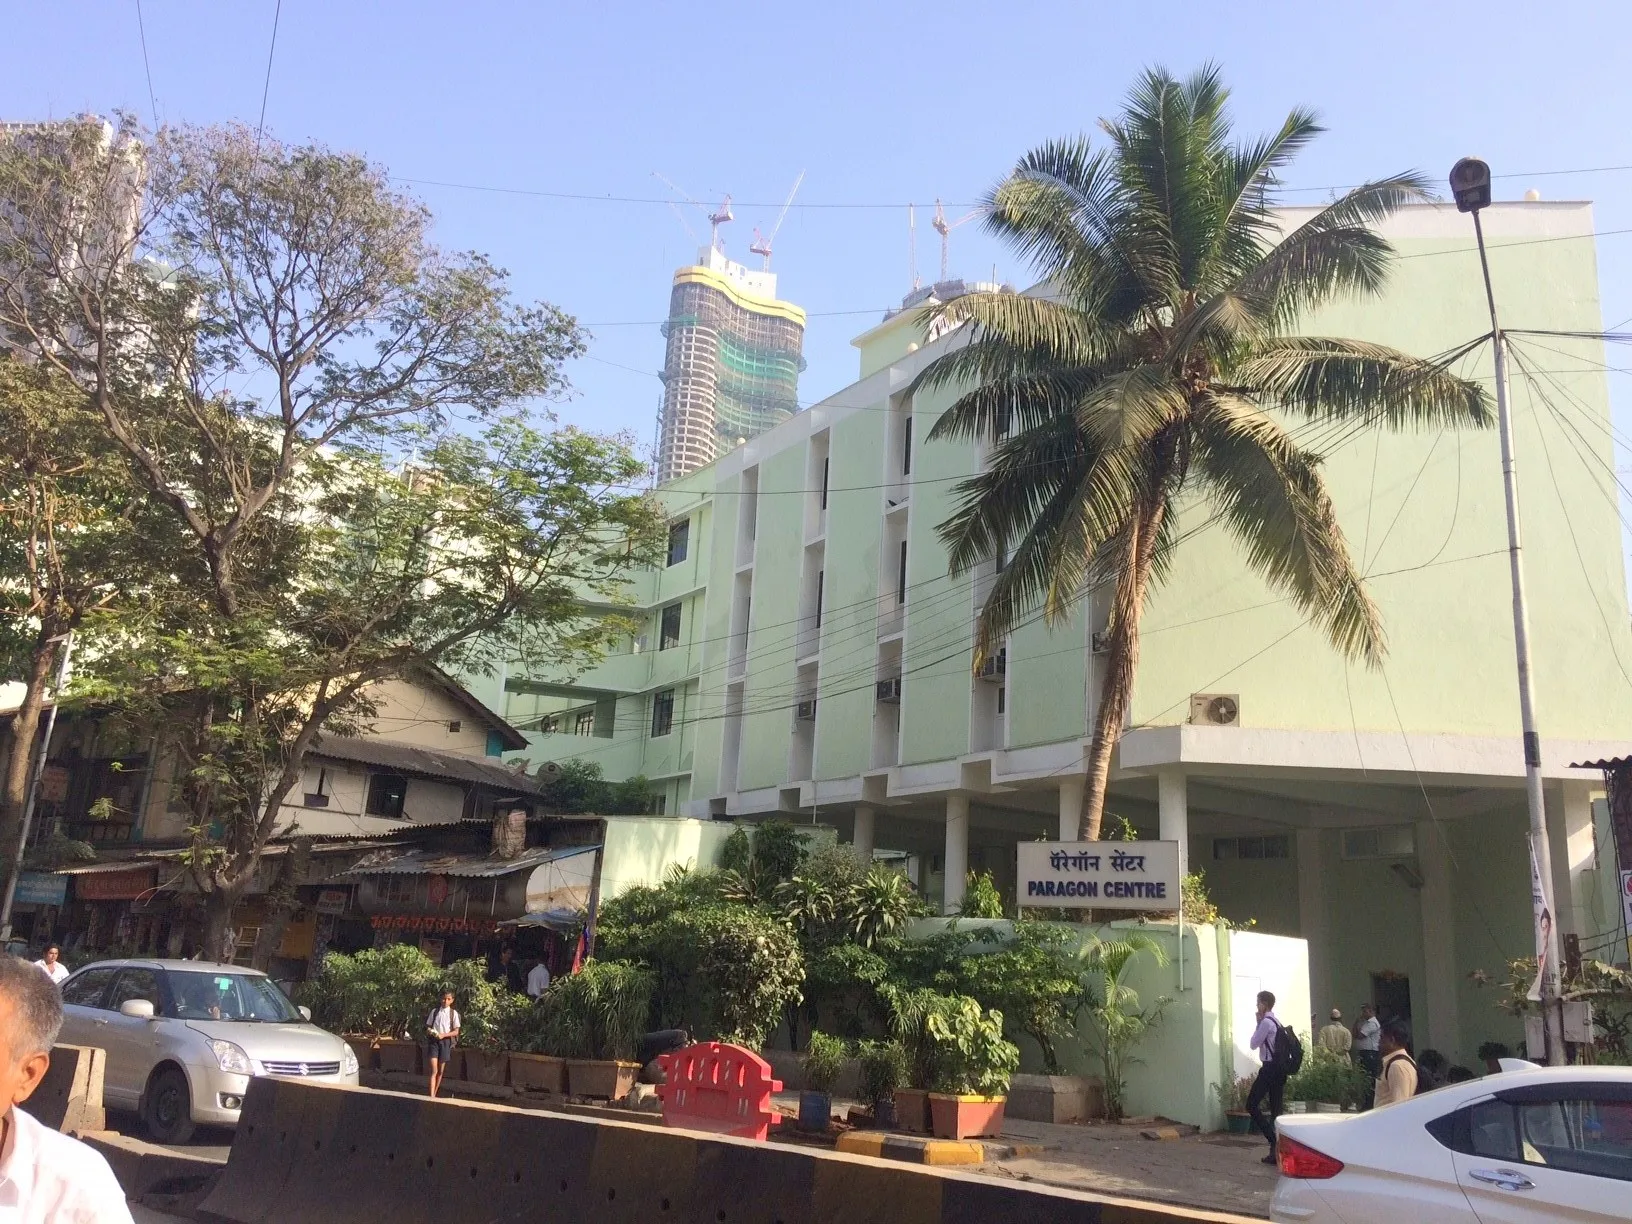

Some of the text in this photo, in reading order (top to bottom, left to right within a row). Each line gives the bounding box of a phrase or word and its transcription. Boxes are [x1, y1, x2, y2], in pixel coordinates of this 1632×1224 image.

[1109, 849, 1146, 872] सेंटर
[1028, 880, 1166, 899] PARAGON CENTRE
